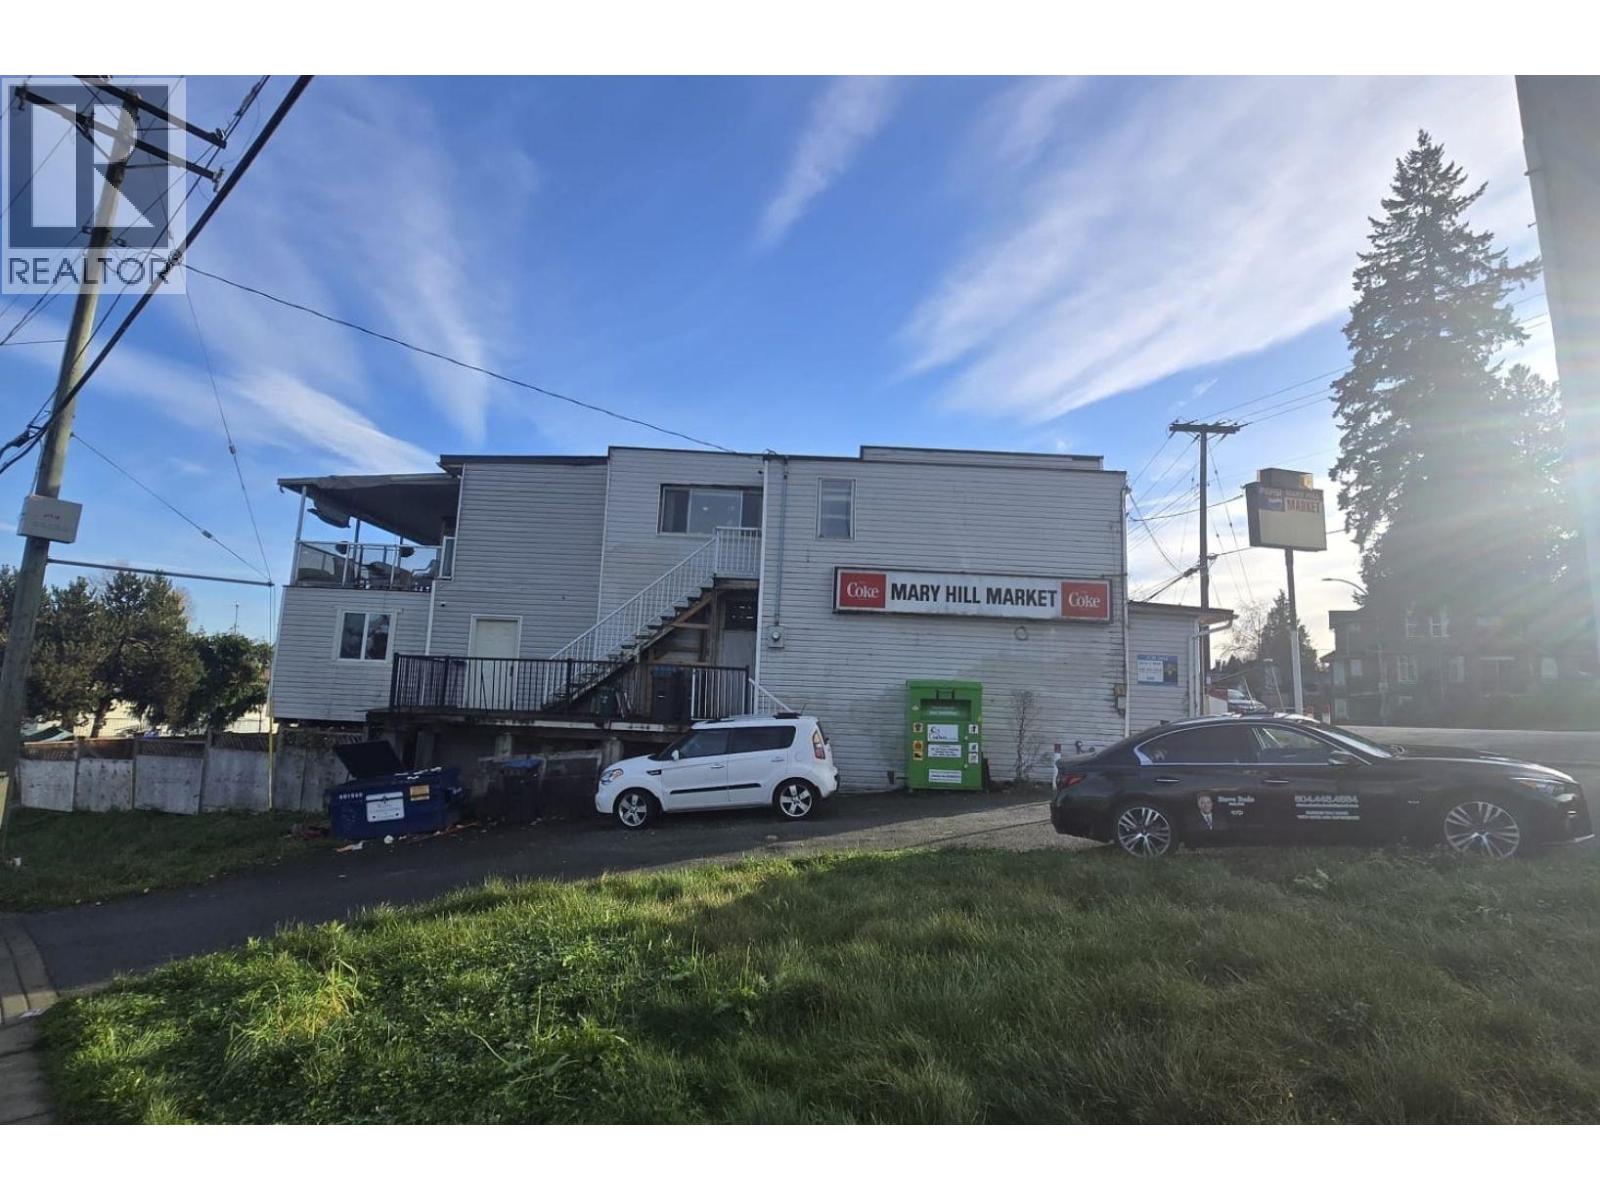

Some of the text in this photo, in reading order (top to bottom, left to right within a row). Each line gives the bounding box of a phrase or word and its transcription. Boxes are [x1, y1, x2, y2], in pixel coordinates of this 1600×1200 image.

[846, 581, 880, 599] Coke
[891, 583, 1058, 607] MARY HILL MARKET
[1068, 591, 1101, 608] Coke
